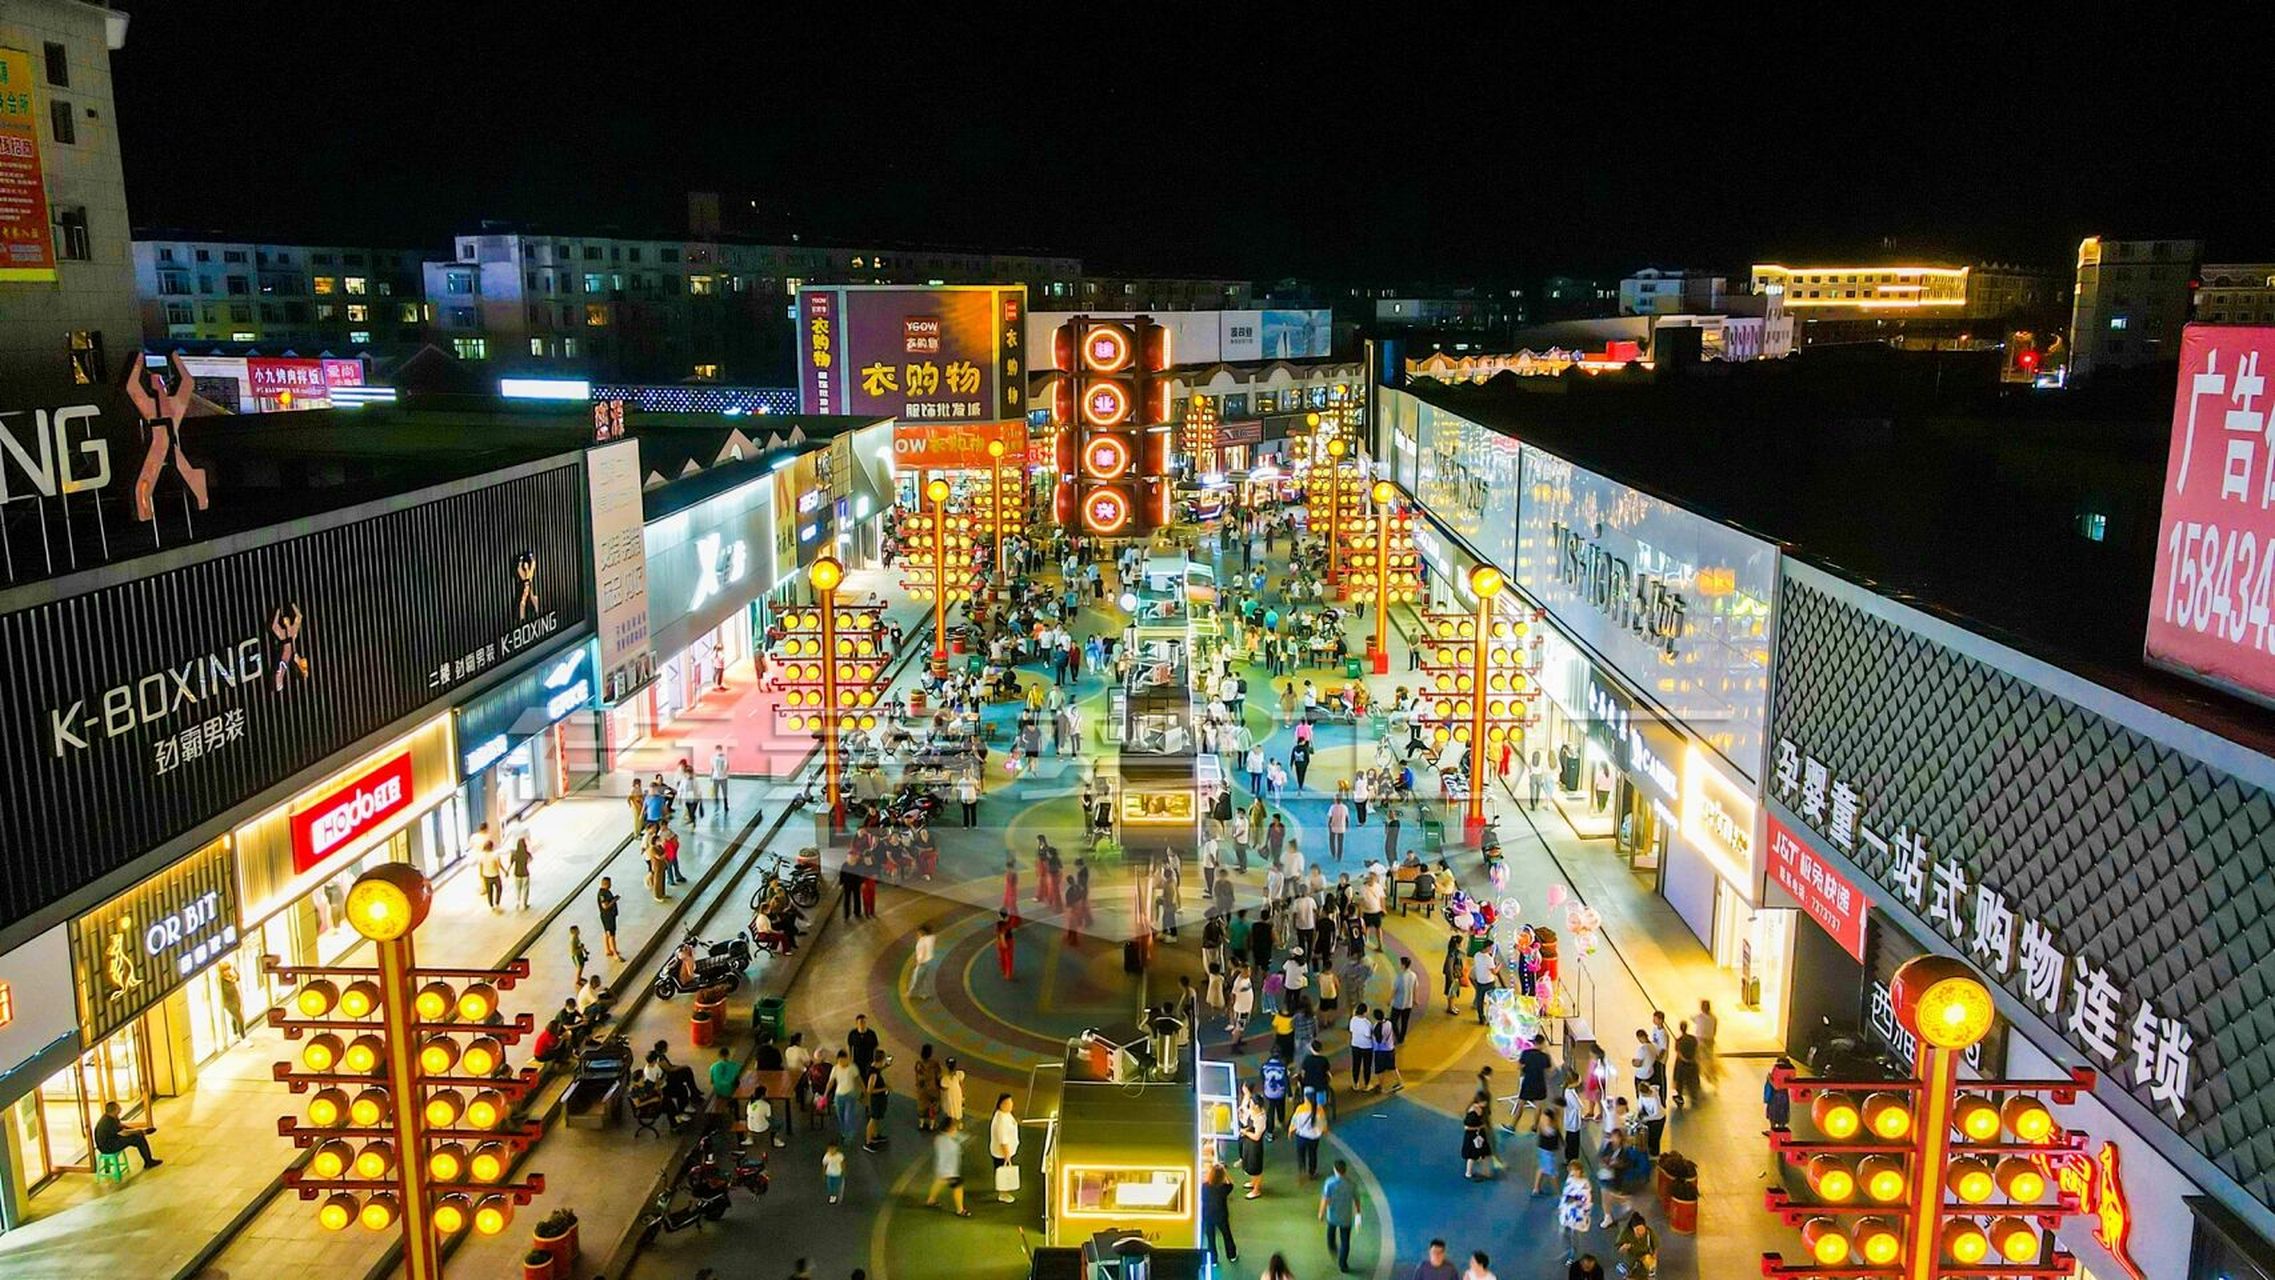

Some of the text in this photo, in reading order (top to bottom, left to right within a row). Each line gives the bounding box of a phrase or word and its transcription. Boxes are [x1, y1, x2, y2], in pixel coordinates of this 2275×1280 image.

[811, 317, 832, 368] 衣购物
[906, 321, 938, 332] YGOW
[861, 361, 981, 397] 衣购物
[2165, 520, 2275, 656] 158434
[501, 611, 557, 656] K-BOXING
[52, 637, 263, 758] K-BOXING
[153, 707, 245, 776] 劲霸男装
[1772, 831, 1850, 918] J&T 极兔快递
[182, 891, 217, 935] BIT
[1776, 737, 2193, 1120] 孕婴童一站式购物连锁
